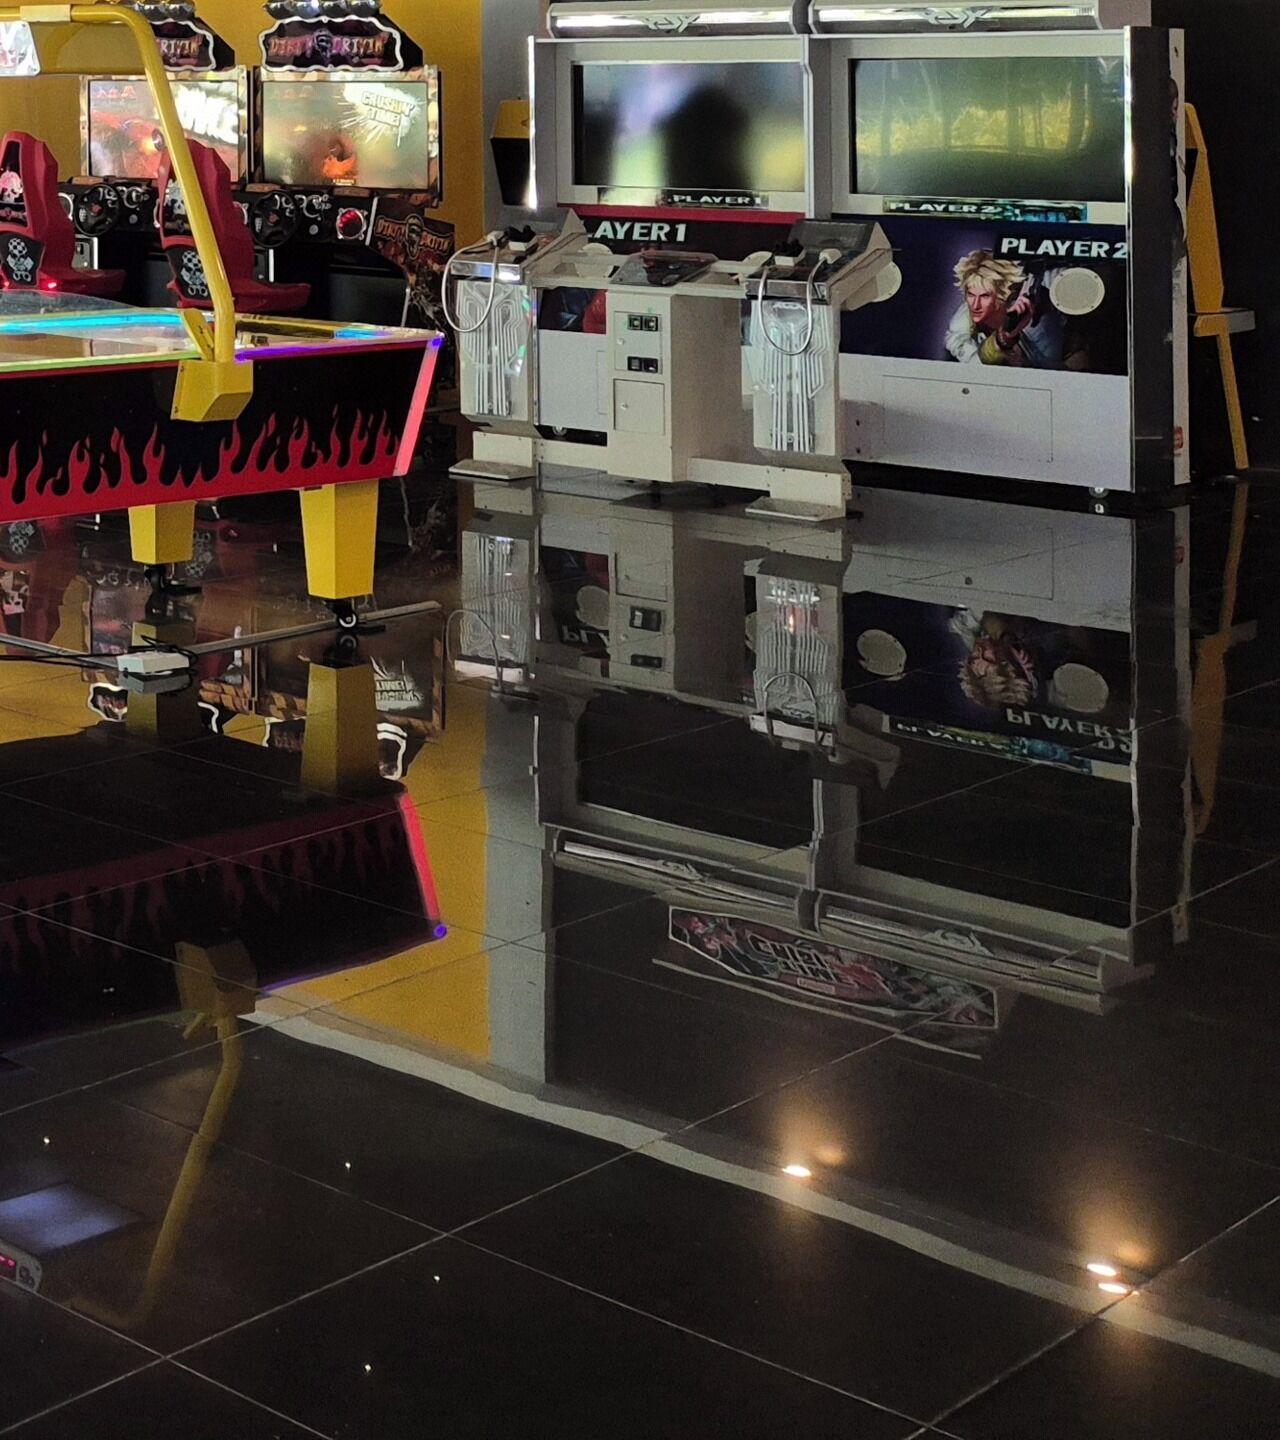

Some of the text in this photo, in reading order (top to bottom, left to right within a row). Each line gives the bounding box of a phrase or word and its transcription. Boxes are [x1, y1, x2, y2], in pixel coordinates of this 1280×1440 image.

[889, 202, 979, 213] PLAYER
[589, 220, 687, 242] AYER 1
[1001, 237, 1128, 258] PLAYER 2
